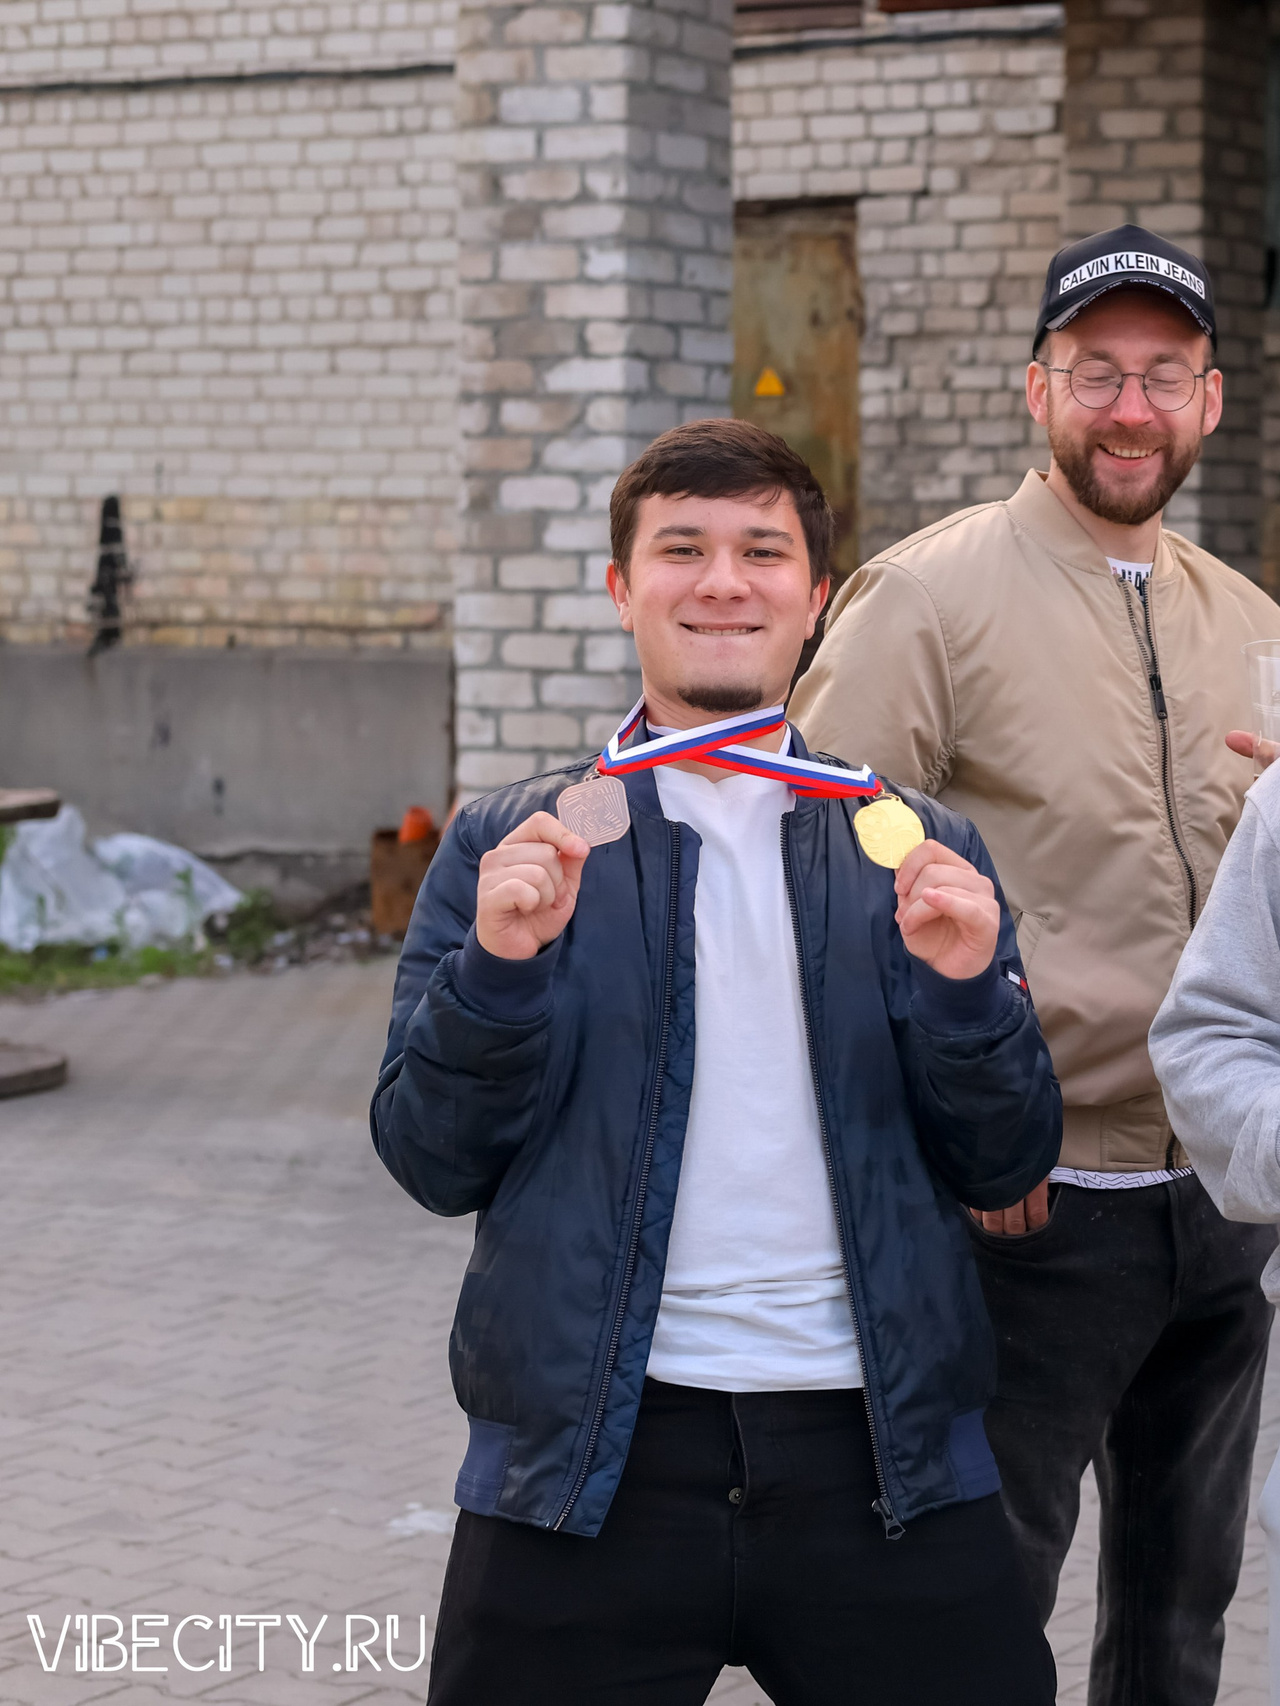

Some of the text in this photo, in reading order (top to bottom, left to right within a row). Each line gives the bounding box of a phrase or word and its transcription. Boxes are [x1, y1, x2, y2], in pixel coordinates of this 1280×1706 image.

[1061, 253, 1205, 296] CALVIN KLEIN JEANS
